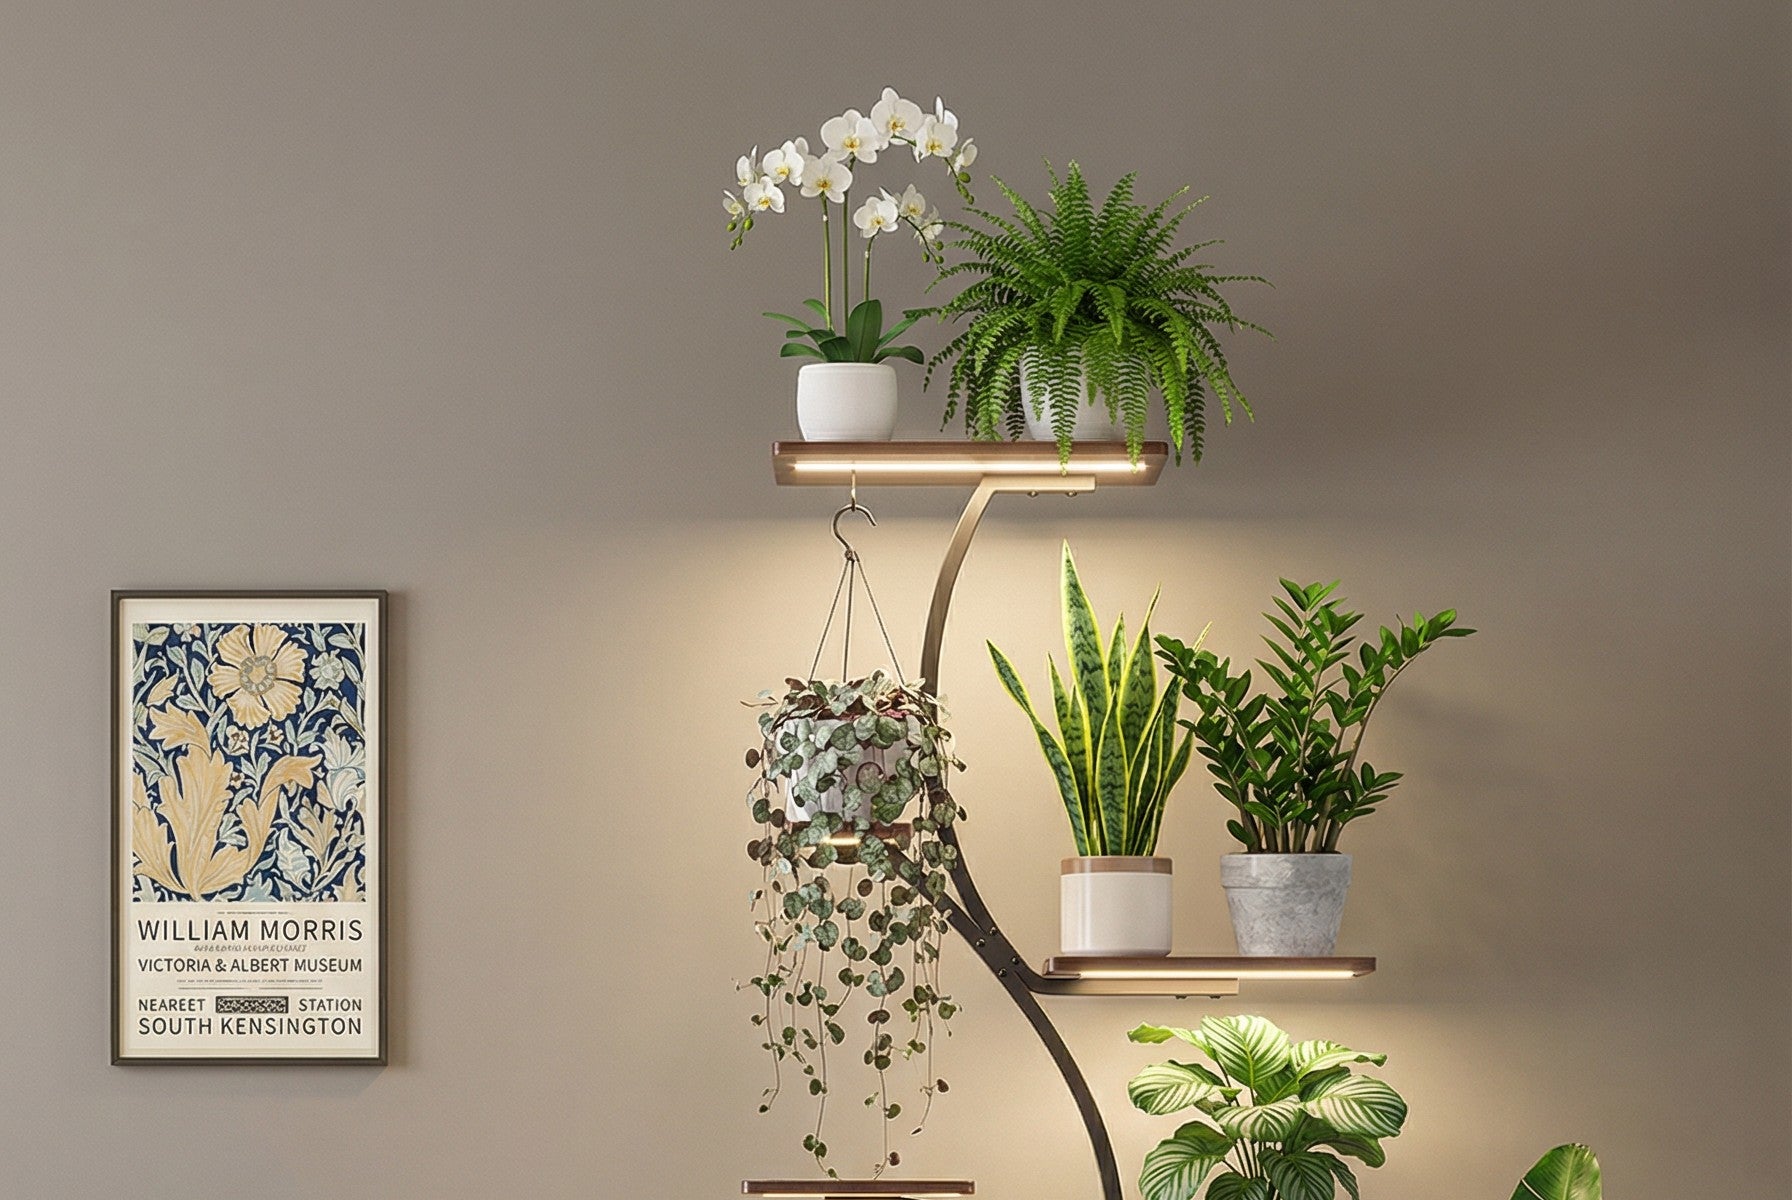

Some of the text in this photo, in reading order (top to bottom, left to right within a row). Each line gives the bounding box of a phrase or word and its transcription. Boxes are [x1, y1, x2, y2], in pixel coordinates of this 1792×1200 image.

[137, 919, 363, 941] WILLIAM MORRIS
[138, 958, 362, 972] VICTORIA & ALBERT MUSEUM
[138, 998, 362, 1012] NEAREET STATION
[138, 1017, 362, 1035] SOUTH KENSINGTON
